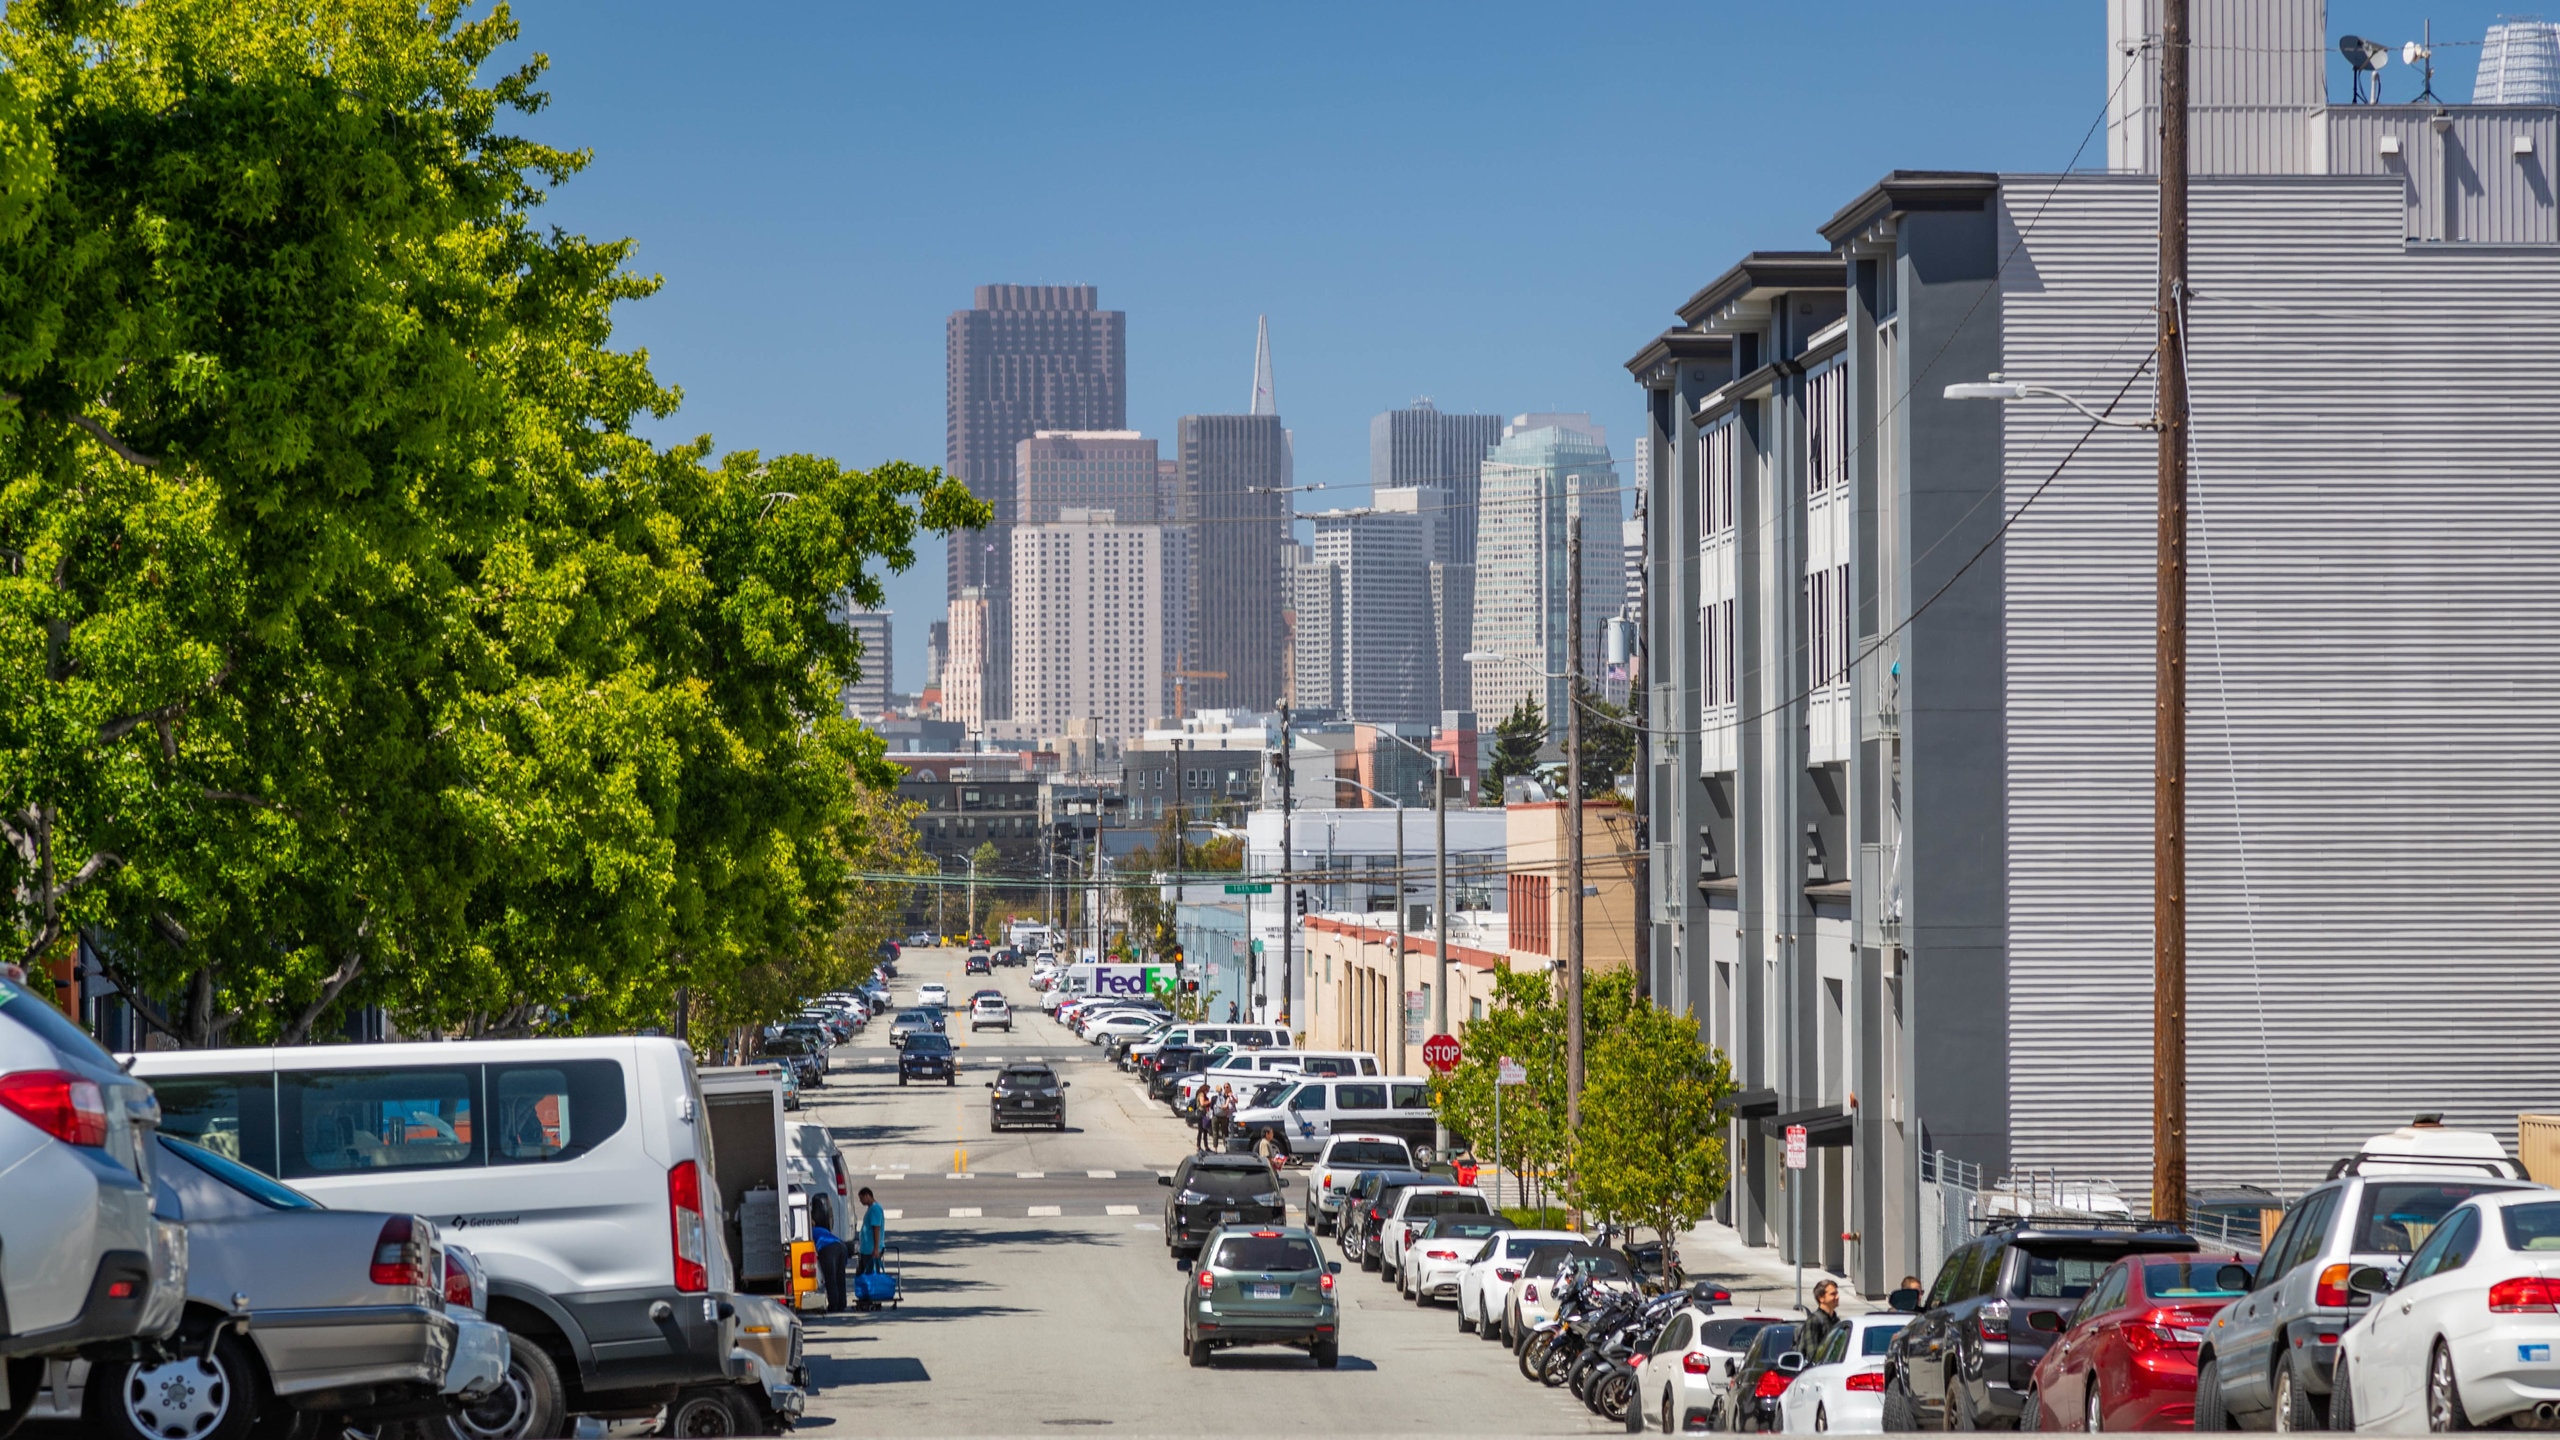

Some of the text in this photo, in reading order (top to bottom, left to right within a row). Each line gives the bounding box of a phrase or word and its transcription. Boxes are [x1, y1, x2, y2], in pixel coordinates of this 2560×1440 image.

[1096, 967, 1177, 994] FedEx
[1425, 1045, 1460, 1062] STOP
[470, 1215, 520, 1227] Getaround
